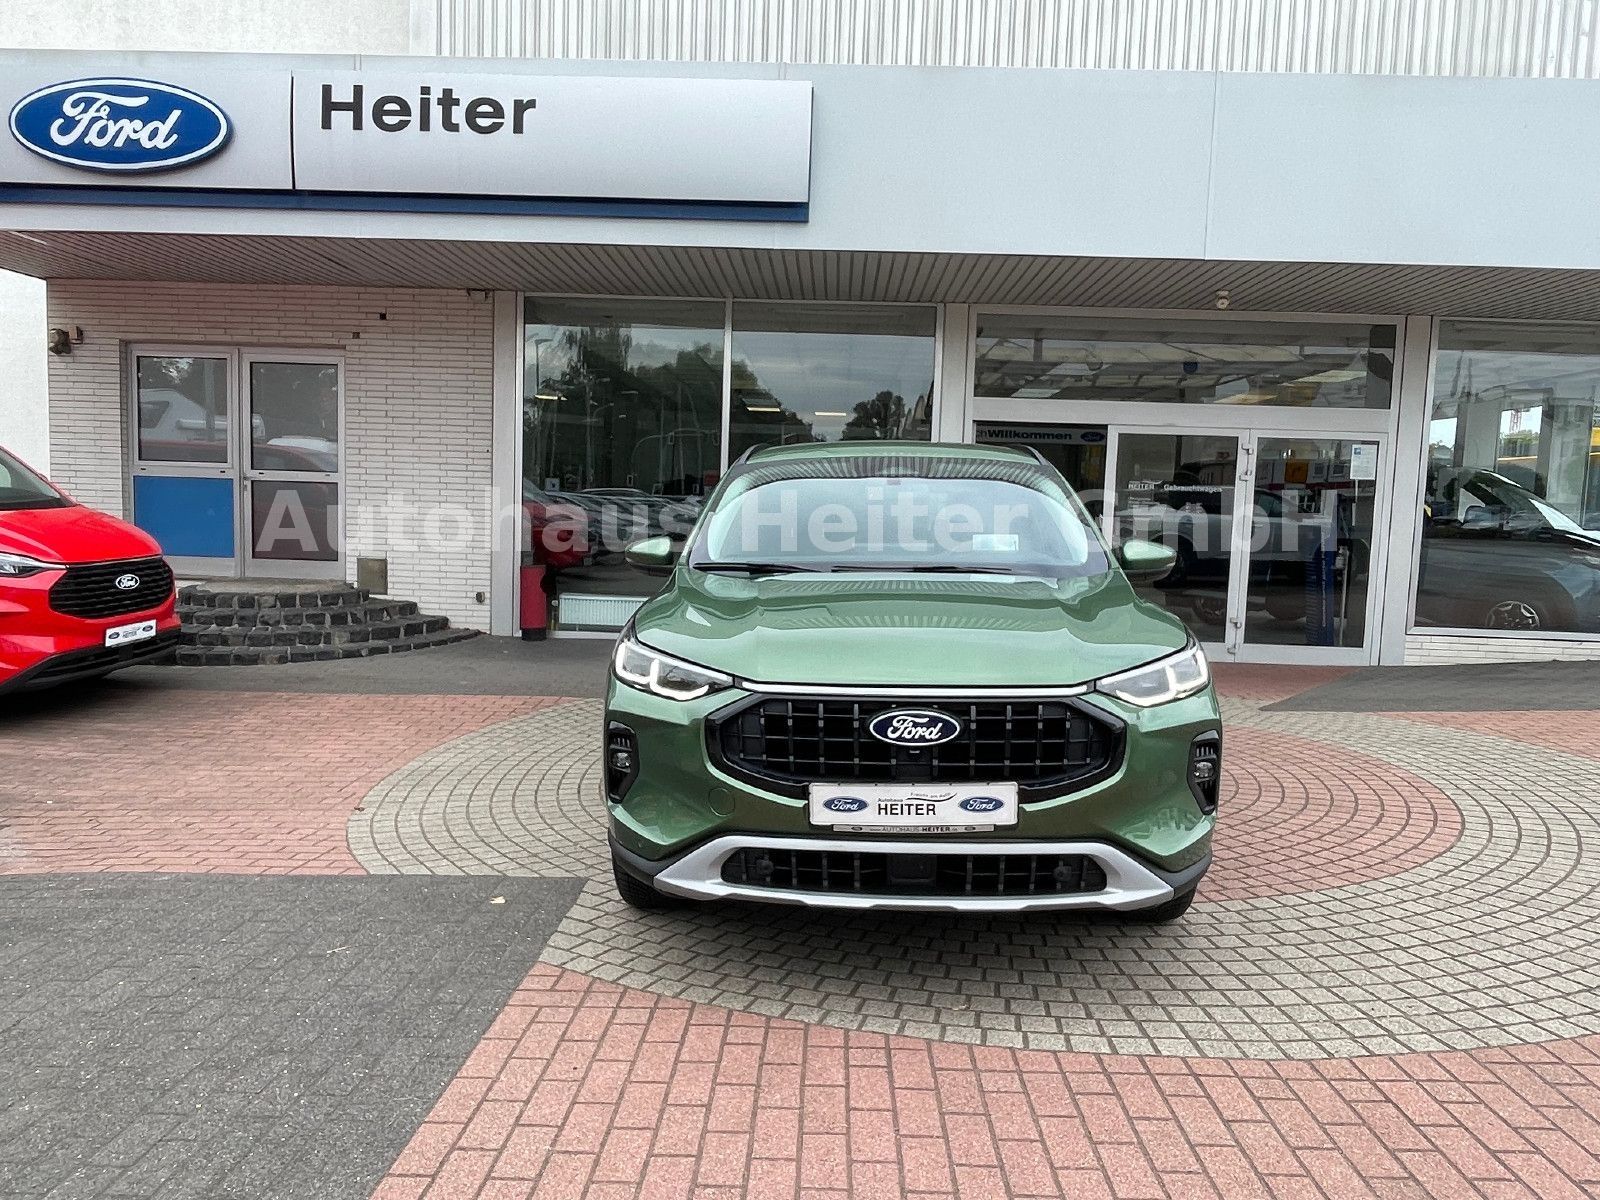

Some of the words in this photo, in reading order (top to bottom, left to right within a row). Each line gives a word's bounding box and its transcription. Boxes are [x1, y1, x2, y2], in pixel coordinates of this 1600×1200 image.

[320, 83, 537, 135] Heiter
[49, 91, 182, 150] Ford
[987, 429, 1073, 440] Willkommen
[119, 576, 137, 588] Ford
[887, 715, 943, 740] Ford
[831, 799, 859, 811] Ford
[877, 803, 936, 816] HEITER
[966, 799, 996, 811] Ford
